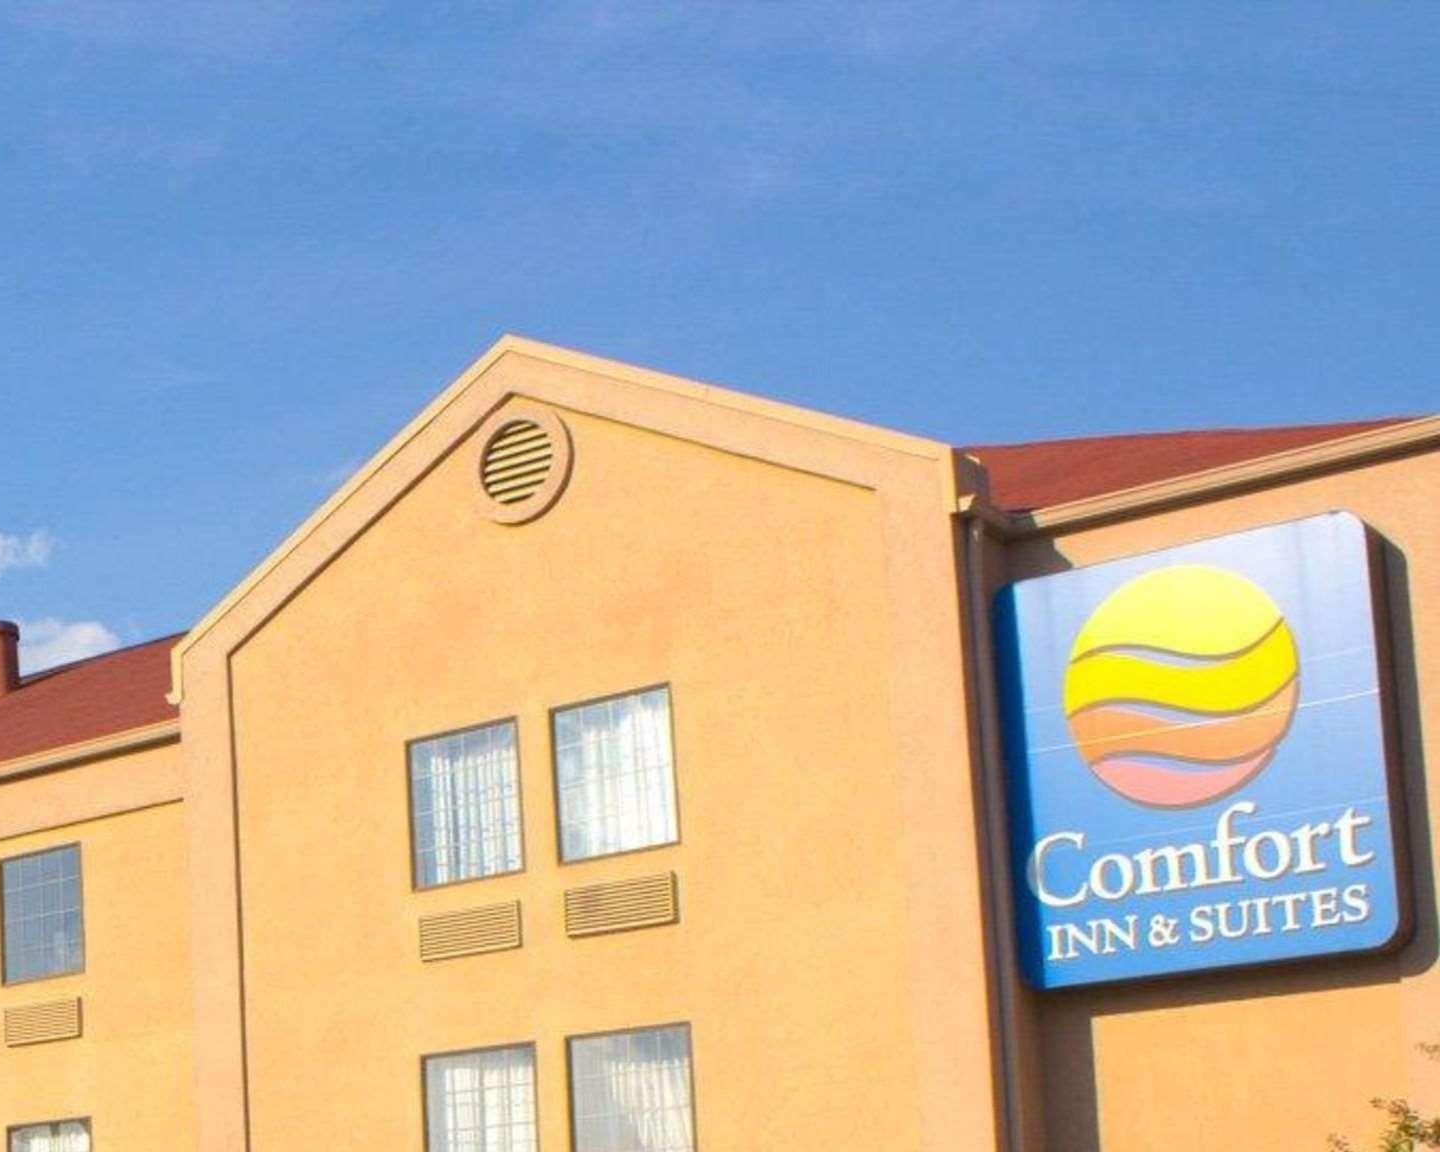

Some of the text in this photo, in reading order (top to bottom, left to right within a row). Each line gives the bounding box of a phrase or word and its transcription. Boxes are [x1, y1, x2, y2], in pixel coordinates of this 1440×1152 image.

[1028, 802, 1374, 907] Comfort
[1047, 884, 1370, 961] INN & SUITES
